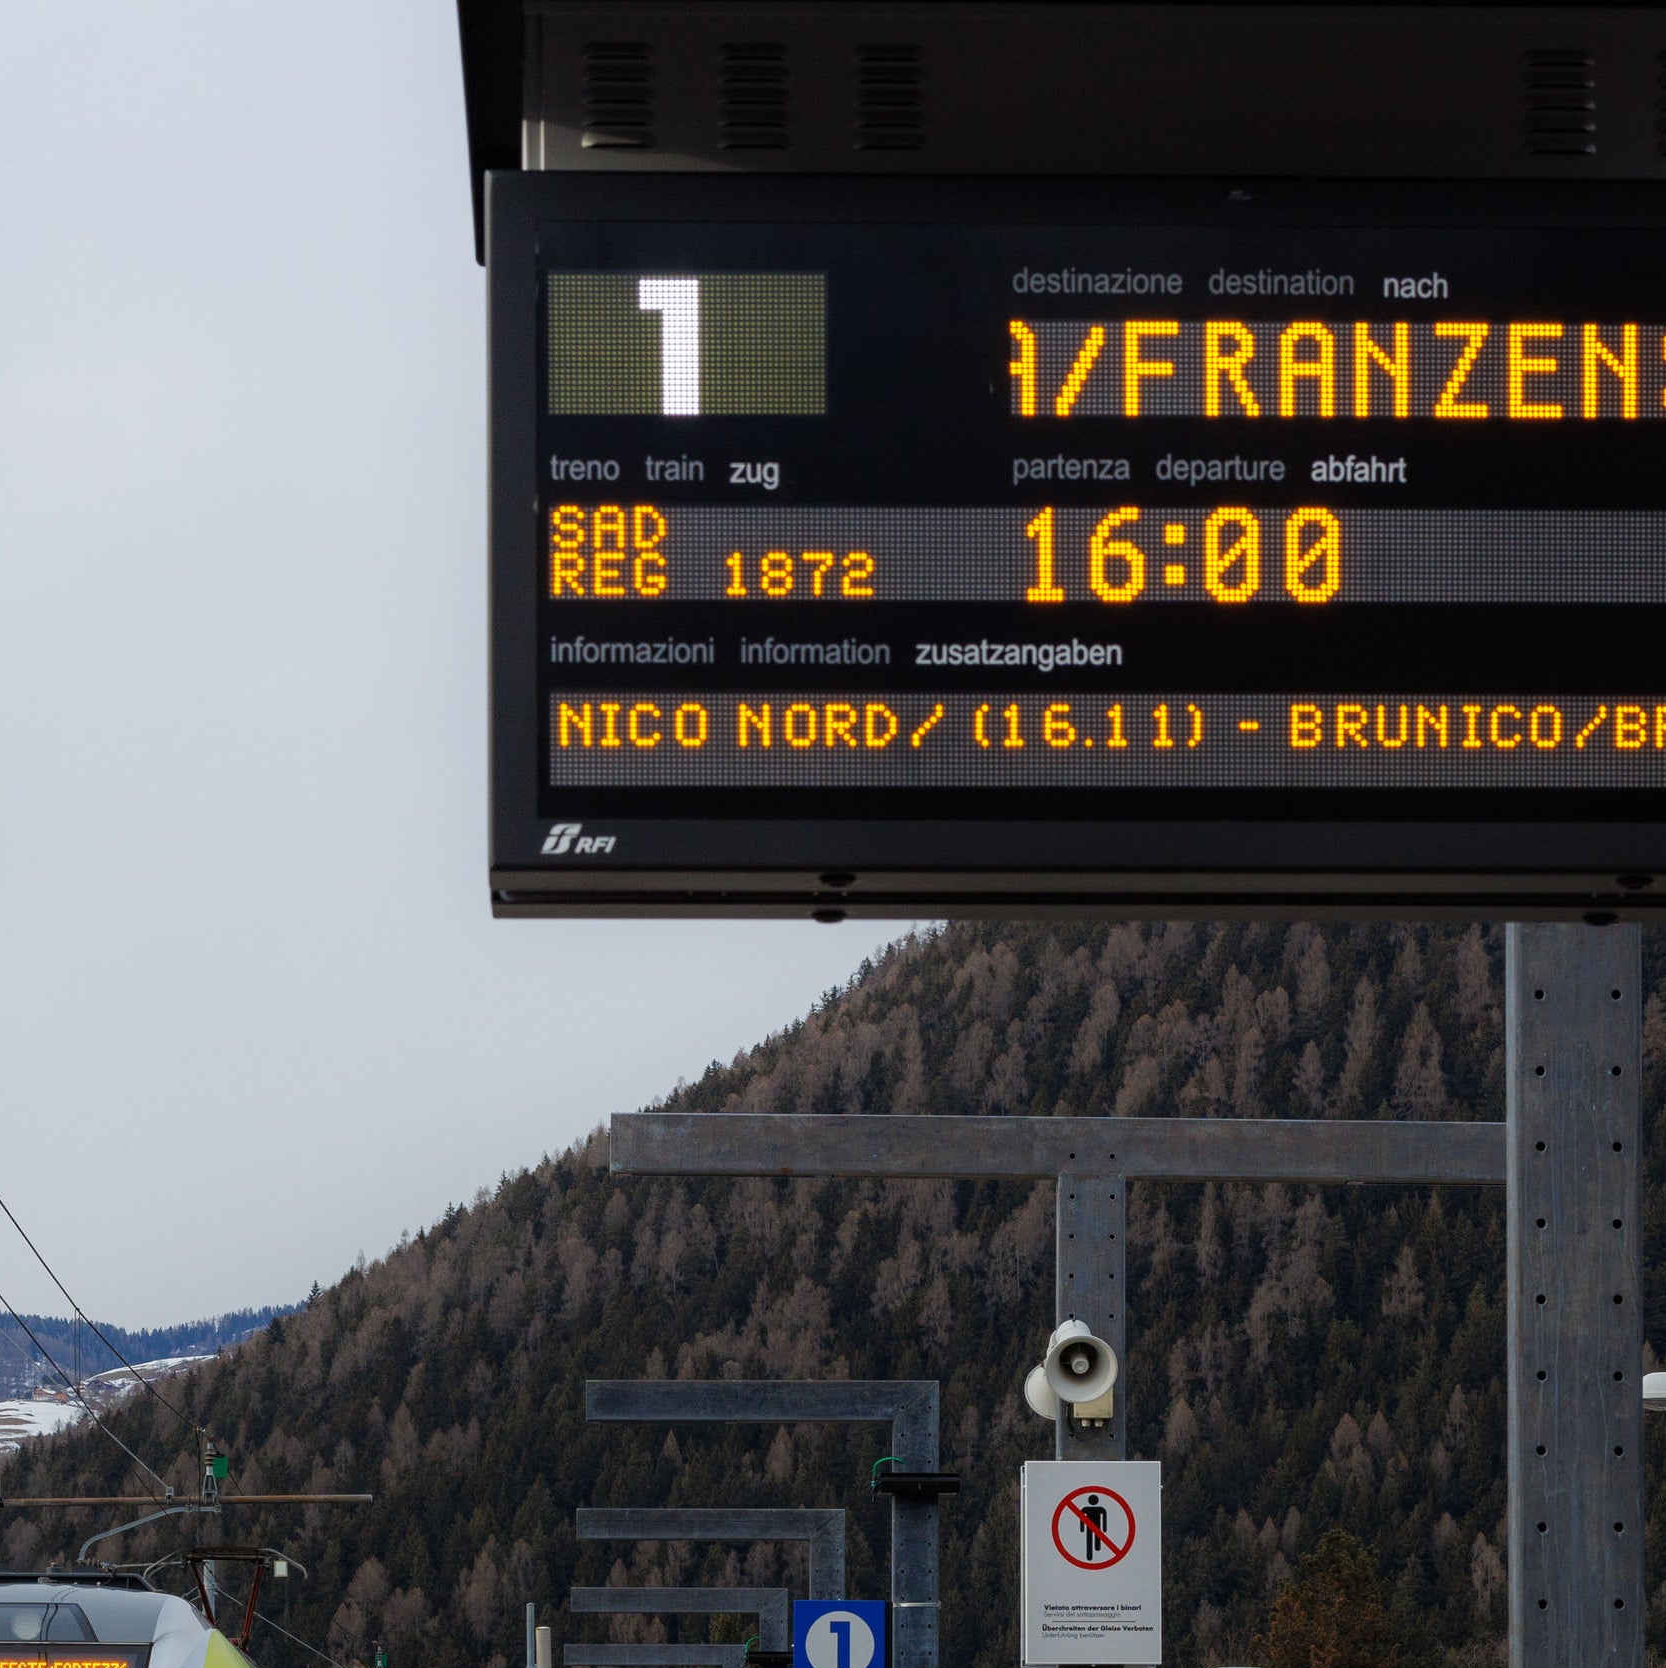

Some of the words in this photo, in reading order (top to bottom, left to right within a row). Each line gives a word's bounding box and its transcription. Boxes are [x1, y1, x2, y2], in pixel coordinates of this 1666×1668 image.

[1012, 267, 1182, 296] destinazione
[1208, 267, 1355, 296] destination
[1383, 271, 1448, 300] nach
[638, 278, 699, 416] 1
[550, 454, 620, 482] treno
[645, 454, 704, 482] train
[730, 460, 780, 491] zug
[1013, 454, 1130, 486] partenza
[1156, 454, 1285, 487] departure
[1311, 455, 1407, 484] abfahrt
[552, 505, 667, 548] SAD
[1025, 506, 1341, 602] 16:00
[552, 552, 667, 597] REG
[725, 552, 875, 597] 1872
[550, 638, 715, 665] informazioni
[741, 638, 891, 666] information
[915, 639, 1123, 672] zusatzangaben
[558, 703, 708, 747] NICO
[738, 703, 943, 747] NORD/
[973, 703, 1203, 748] (16.11)
[574, 836, 616, 854] RFI
